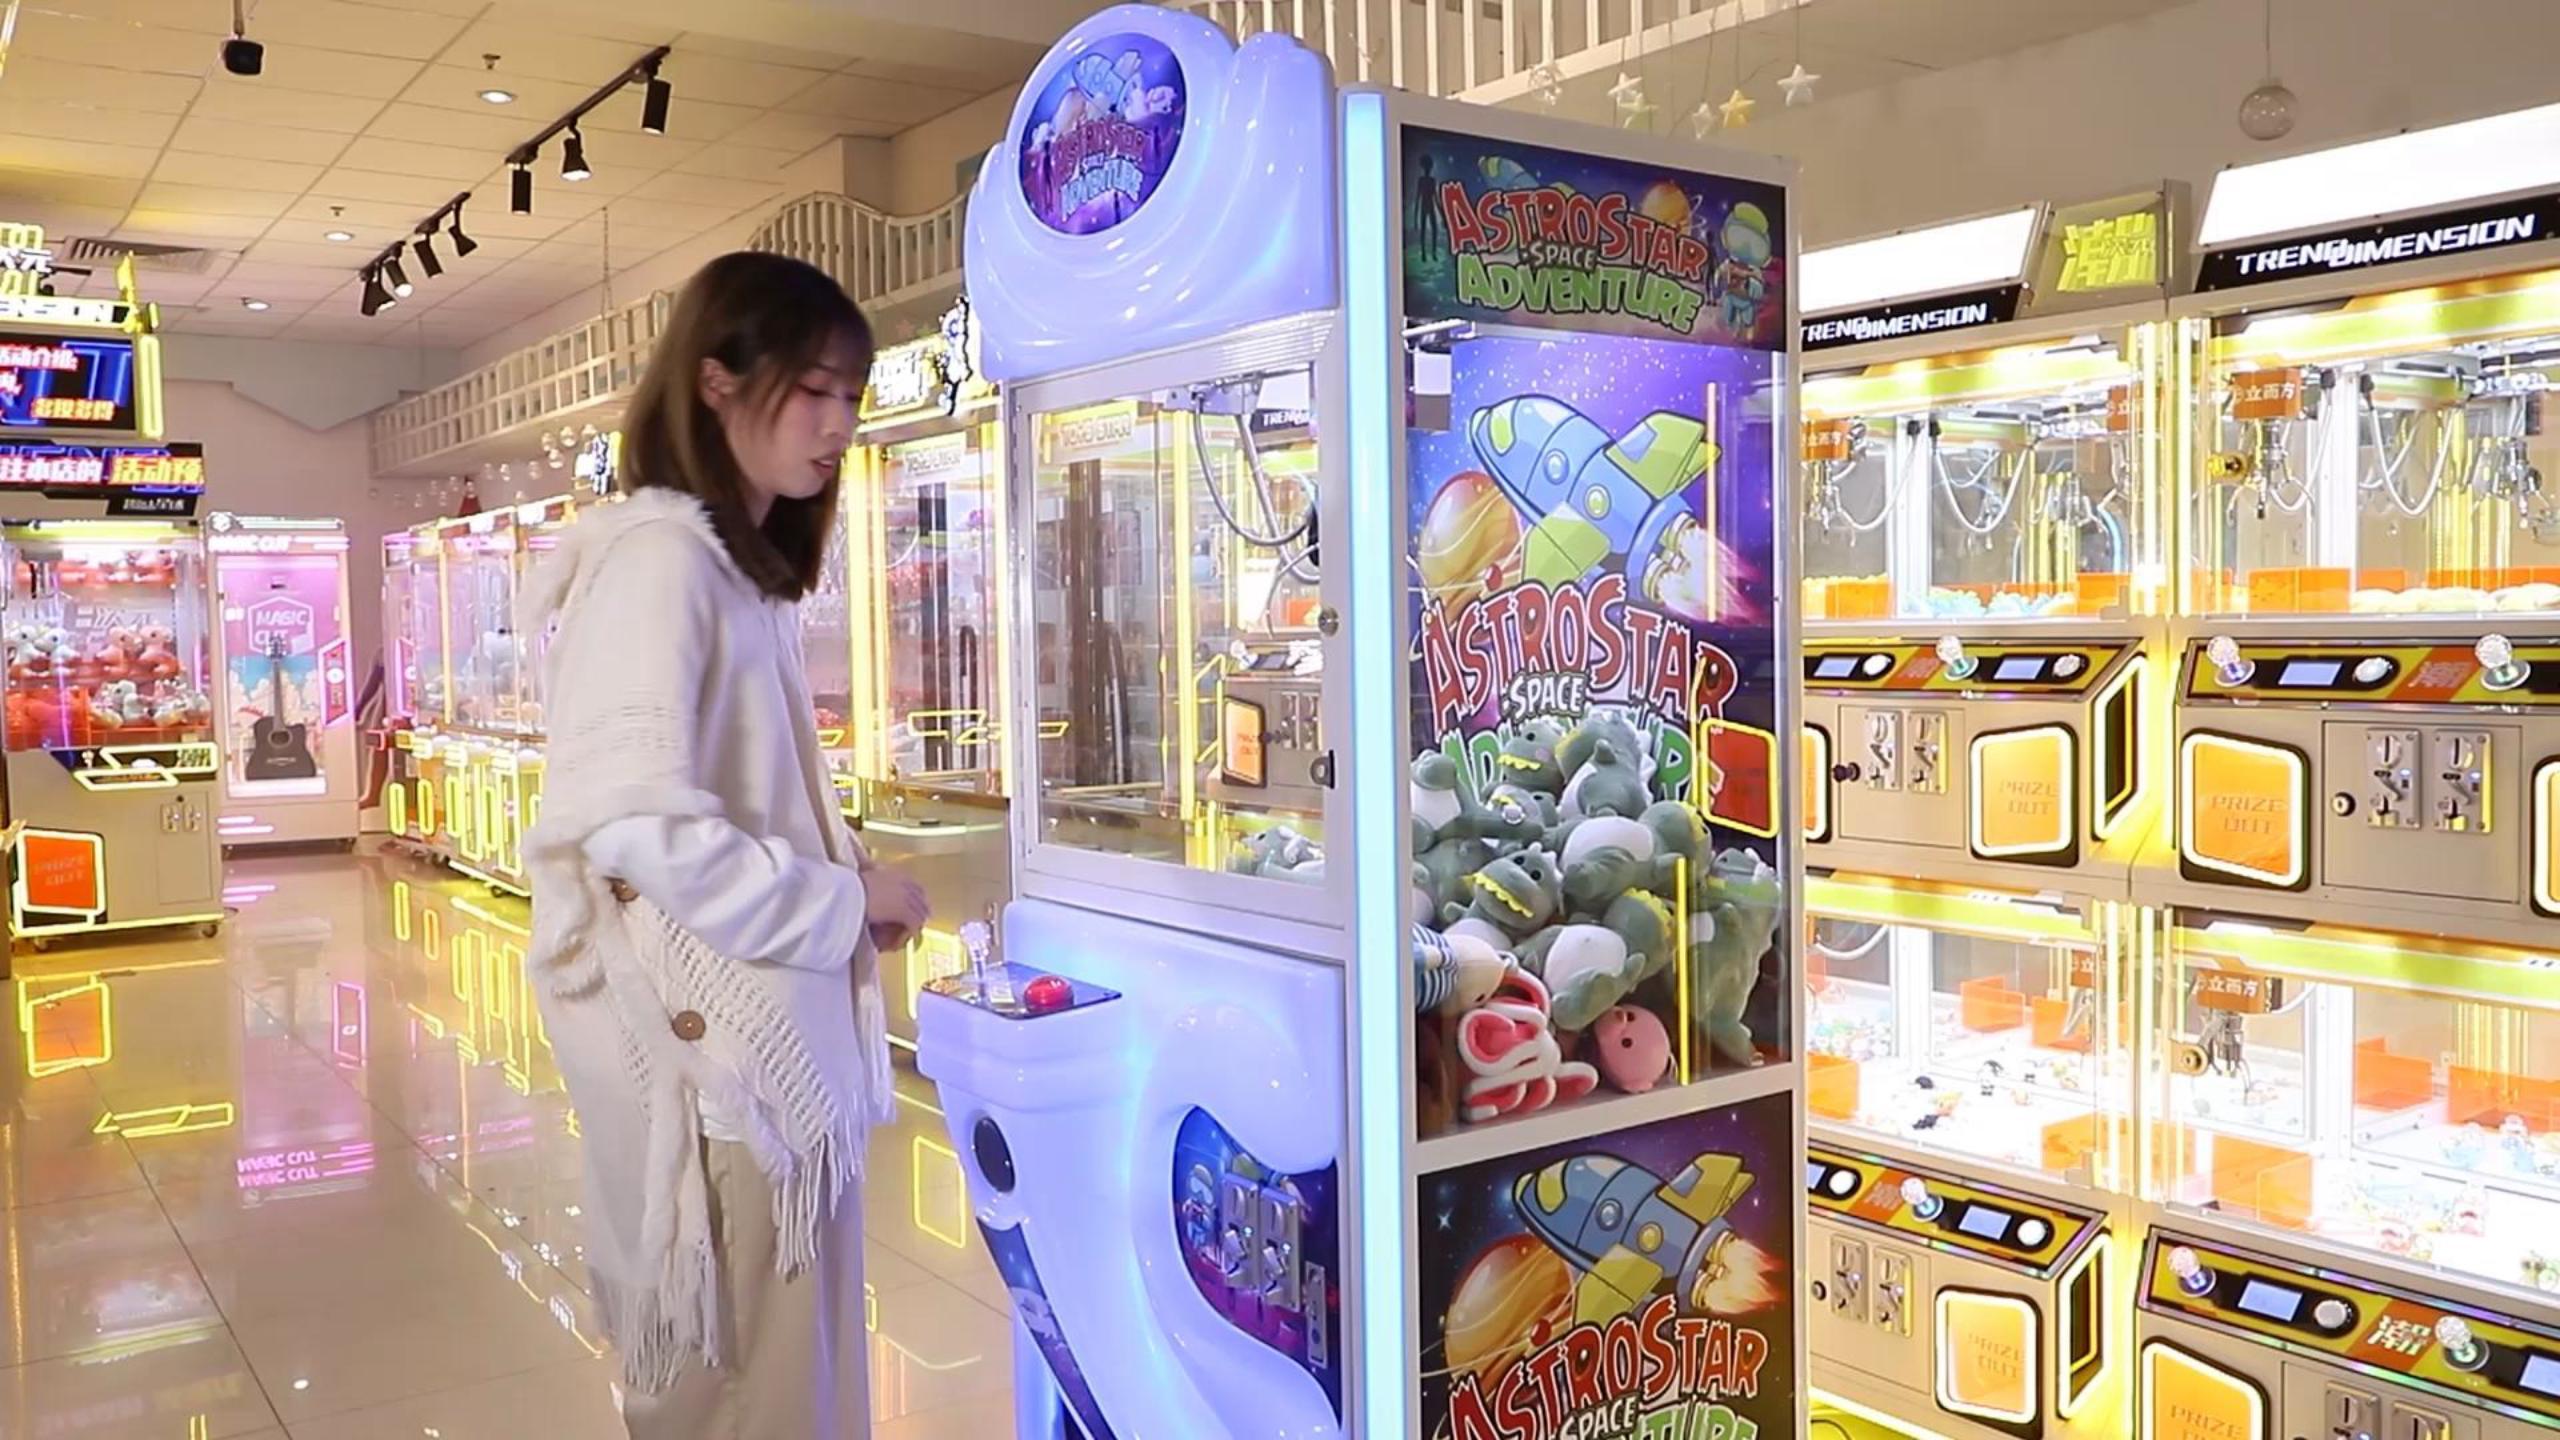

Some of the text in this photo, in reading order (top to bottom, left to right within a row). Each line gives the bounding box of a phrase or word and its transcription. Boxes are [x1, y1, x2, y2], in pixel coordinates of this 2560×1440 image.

[1441, 181, 1709, 282] ASTROSTAR
[1528, 241, 1597, 269] SPACE
[1458, 253, 1703, 333] ADVENTURE
[1421, 574, 1739, 743] ASTROSTAR
[1508, 674, 1587, 721] SPACE
[1449, 1294, 1768, 1440] ASTROSTAR
[1561, 1396, 1638, 1440] SPACE
